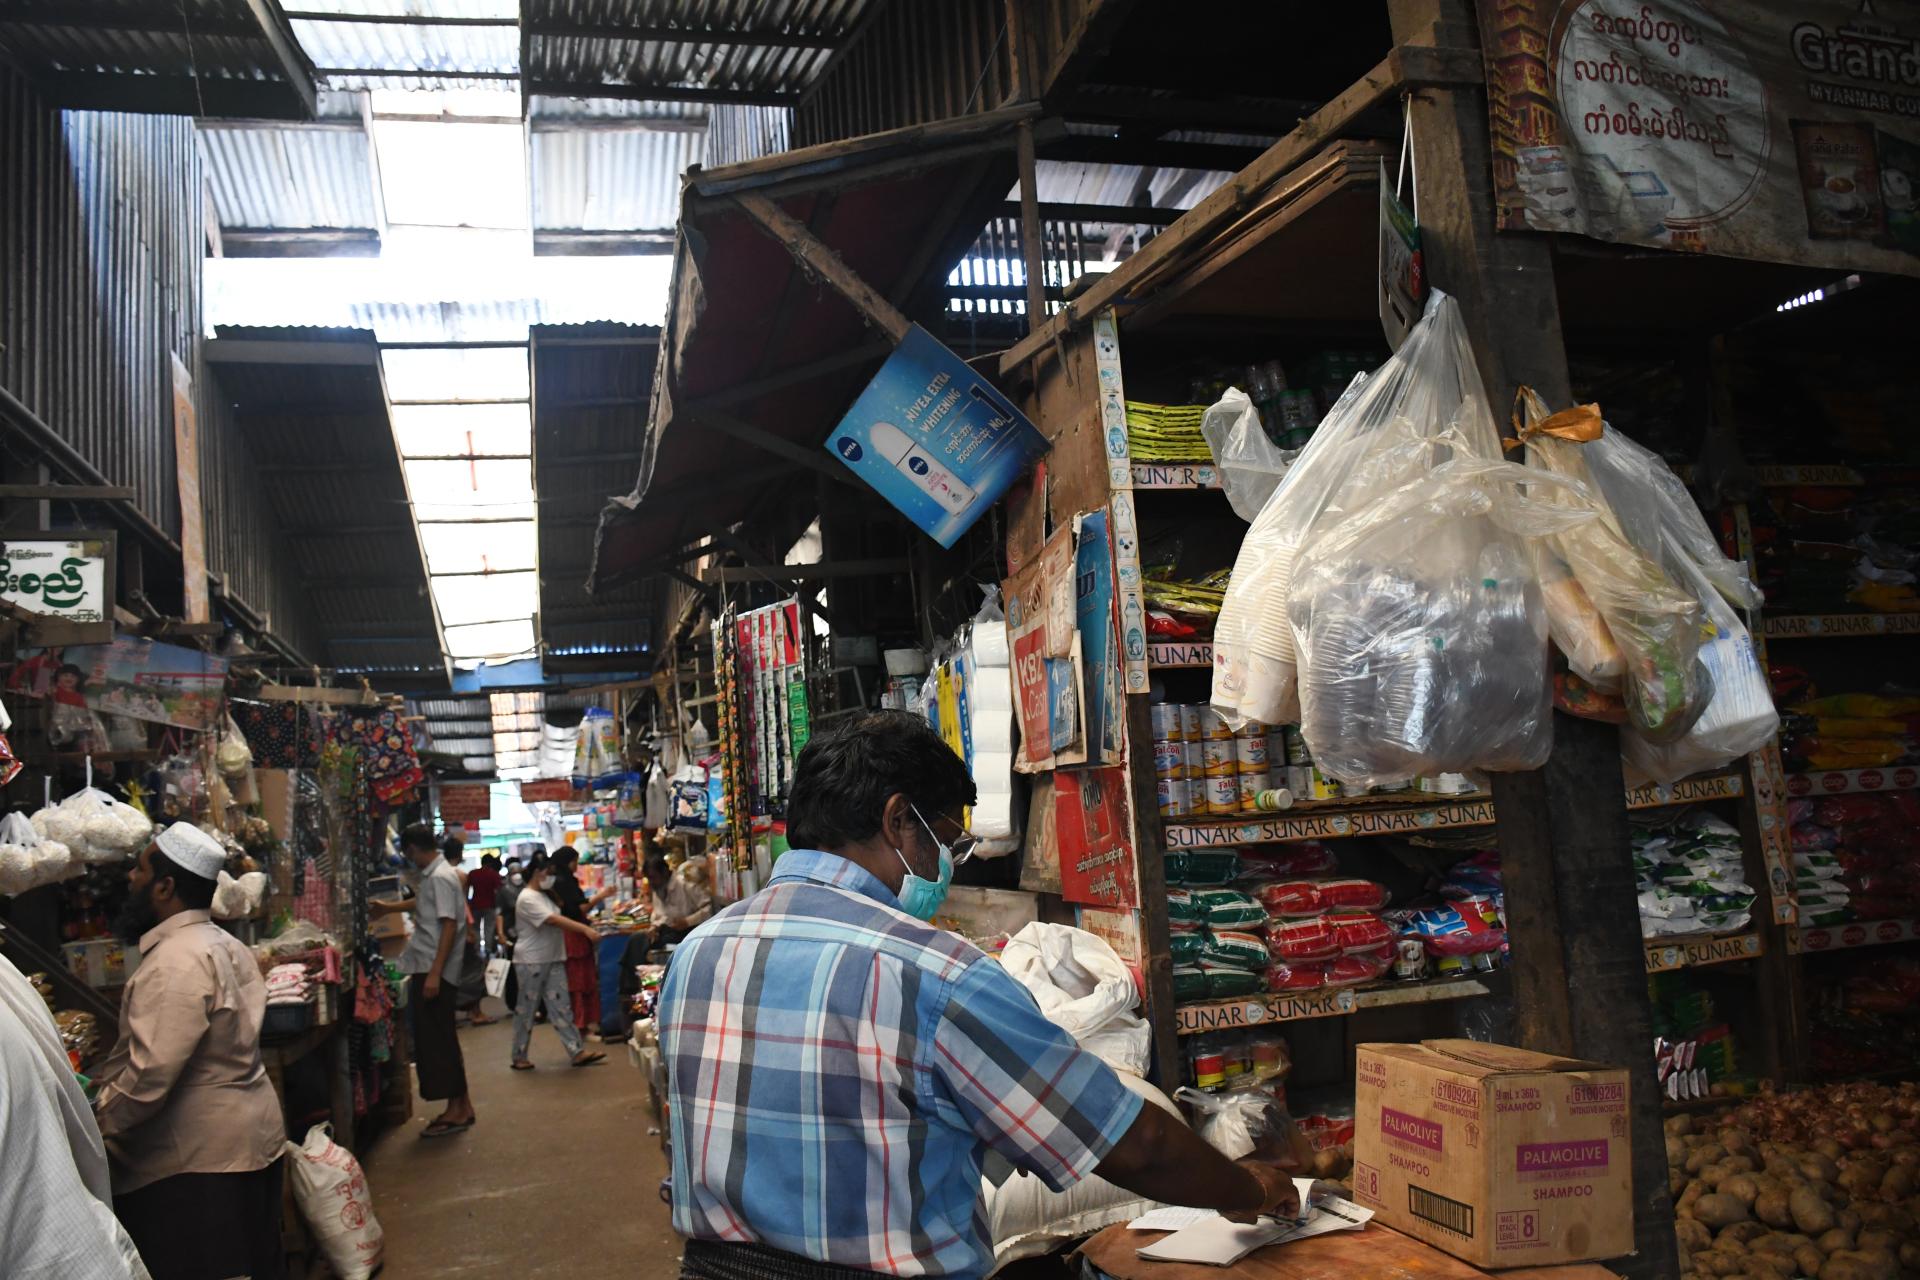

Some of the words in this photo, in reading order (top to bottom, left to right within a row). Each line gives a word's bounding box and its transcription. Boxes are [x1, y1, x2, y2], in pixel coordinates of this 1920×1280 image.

[1792, 24, 1920, 86] Grand
[1808, 83, 1890, 111] MYANMAR
[905, 394, 930, 422] NIVEA
[927, 370, 952, 396] EXTRA
[919, 387, 962, 433] WHITENING
[843, 441, 858, 458] NIVEA
[1148, 646, 1213, 665] SUNAR
[1018, 652, 1043, 689] KBZ
[1672, 779, 1727, 800] SUNAR
[1166, 827, 1240, 848] SUNAR
[1262, 817, 1332, 840] SUNAR
[1351, 813, 1419, 834] SUNAR
[1687, 940, 1744, 962] SUNAR
[1176, 1008, 1244, 1031] SUNAR
[1267, 998, 1336, 1020] SUNAR
[1495, 1101, 1542, 1113] SHAMPOO
[1384, 1113, 1440, 1145] PALMOLIVE
[1389, 1153, 1430, 1177] SHAMPOO
[1523, 1146, 1603, 1165] PALMOLIVE
[1370, 1172, 1377, 1195] 8
[1533, 1185, 1593, 1200] SHAMPOO
[1523, 1214, 1534, 1238] 8
